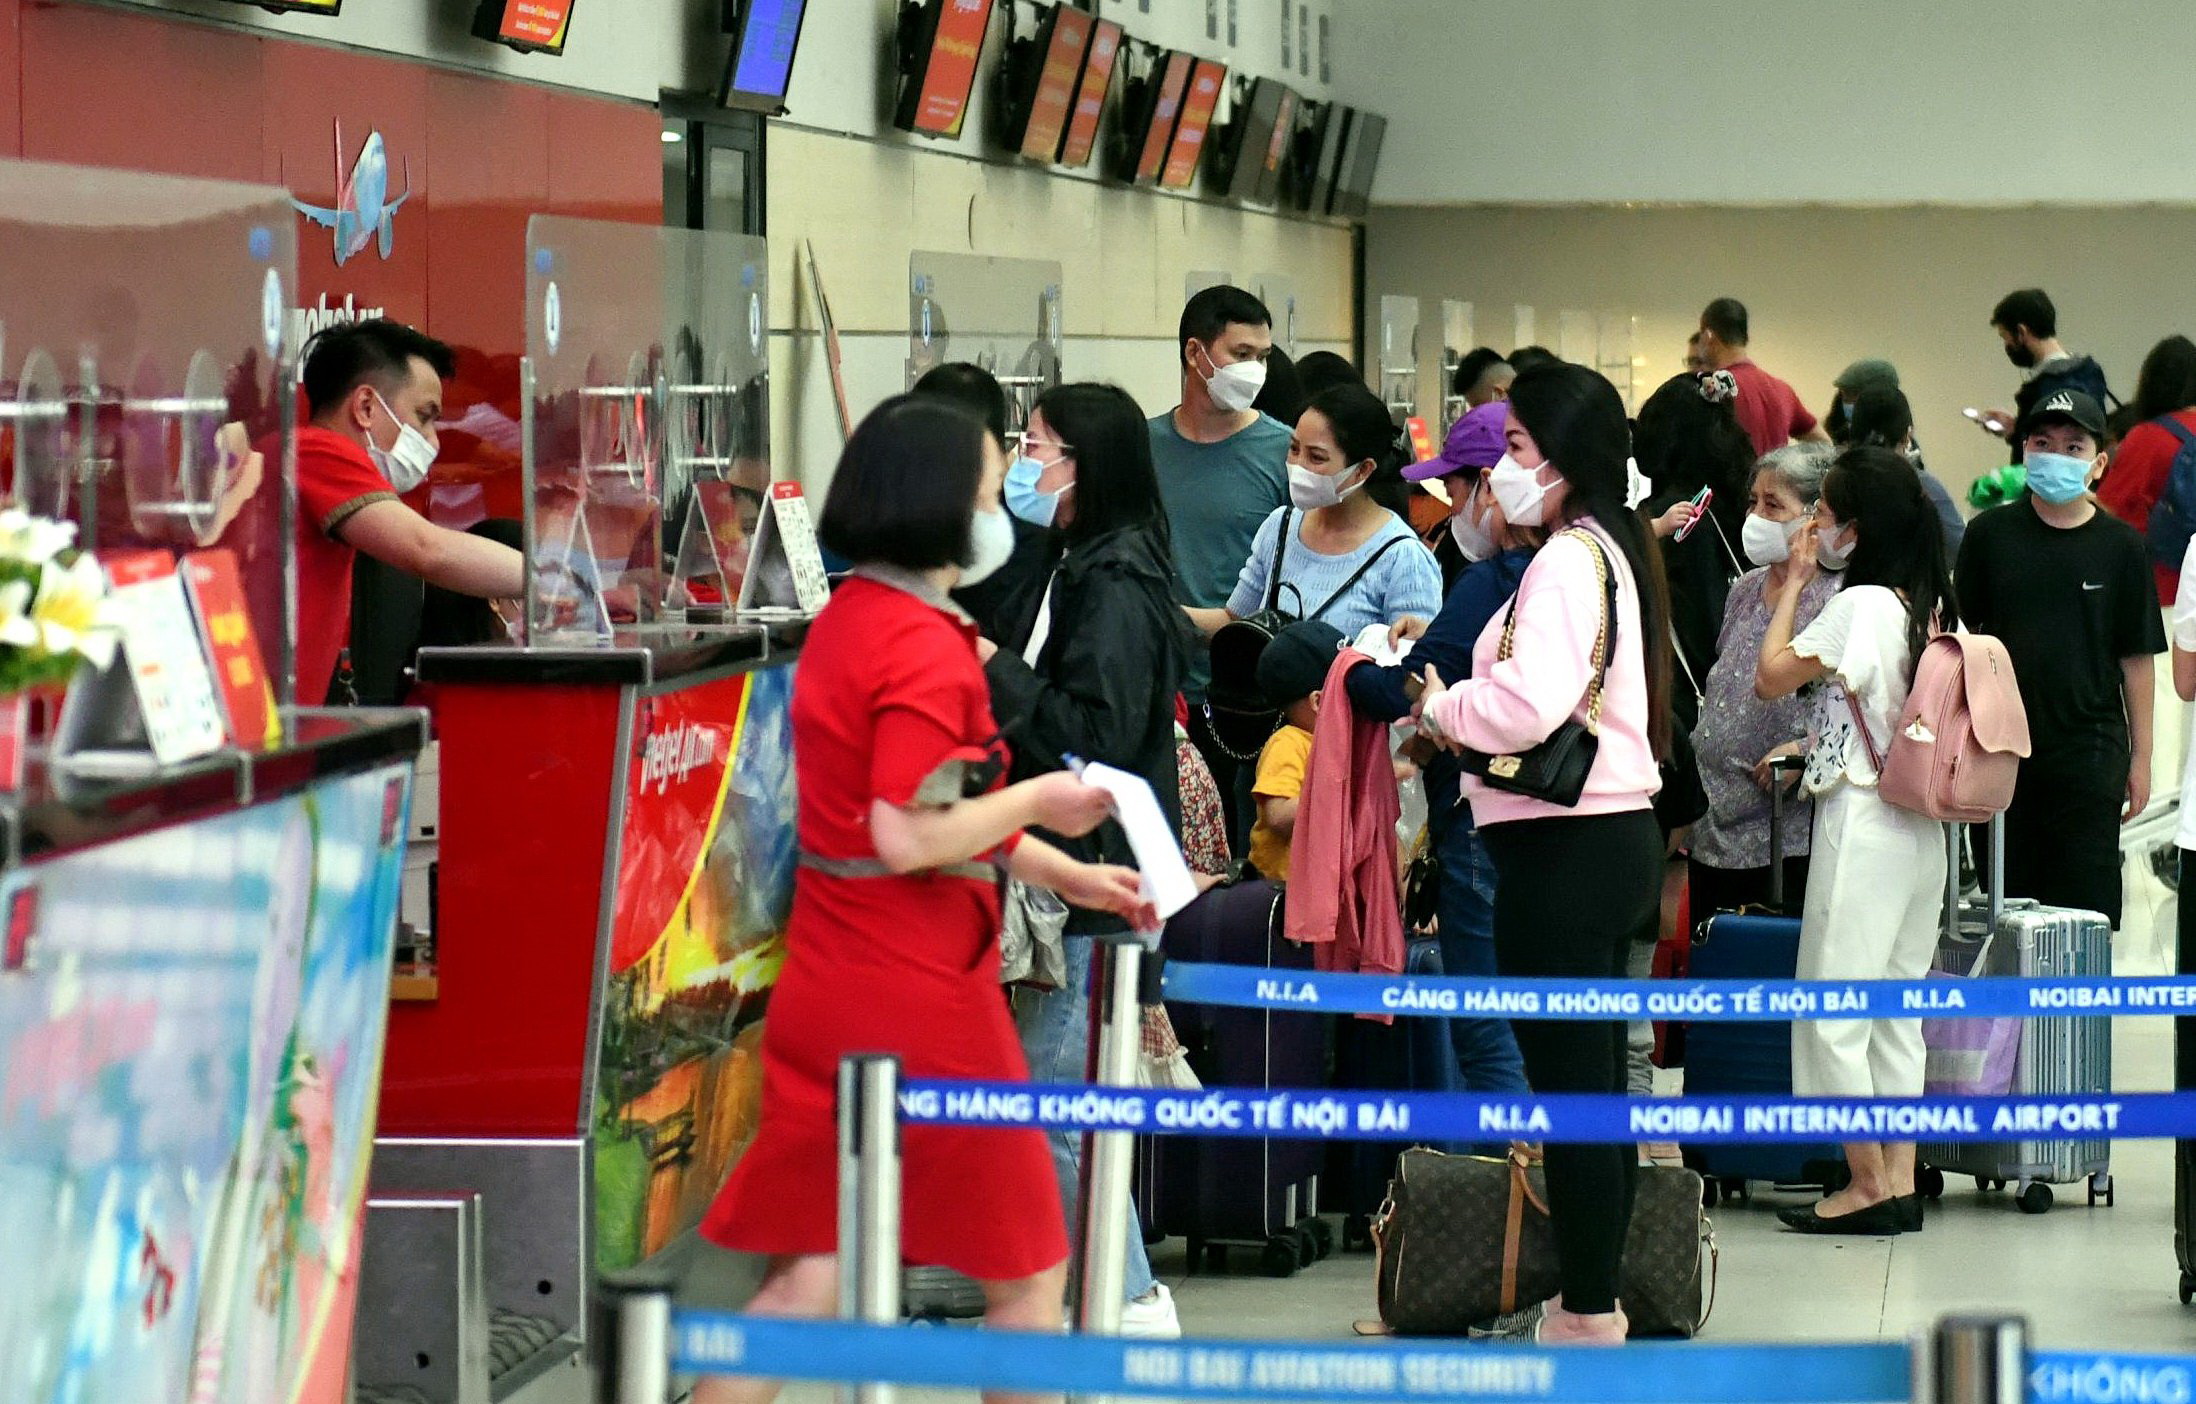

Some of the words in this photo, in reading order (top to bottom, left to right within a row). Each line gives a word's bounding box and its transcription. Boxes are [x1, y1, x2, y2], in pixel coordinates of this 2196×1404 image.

[1257, 980, 1317, 1003] N.I.A
[1382, 981, 1457, 1010] CẢNG
[1464, 986, 1539, 1012] HÀNG
[1547, 989, 1640, 1013] KHÔNG
[1647, 985, 1723, 1013] QUỐC
[1730, 985, 1763, 1012] TẾ
[1770, 988, 1816, 1017] NỘI
[1823, 986, 1868, 1011] BÀI
[1903, 988, 1965, 1009] N.I.A
[2028, 987, 2120, 1009] NOIBAI
[946, 1087, 1033, 1122] HÀNG
[1039, 1090, 1145, 1126] KHÔNG
[1155, 1090, 1243, 1129] QUỐC
[1249, 1091, 1291, 1129] TẾ
[1292, 1099, 1348, 1135] NỘI
[1356, 1101, 1409, 1132] BÀI
[1479, 1103, 1552, 1133] N.I.A
[1630, 1104, 1733, 1134] NOIBAI
[1744, 1104, 1978, 1134] INTERNATIONAL
[1991, 1102, 2122, 1133] AIRPORT
[1250, 1349, 1395, 1392] AVIATION
[1402, 1354, 1555, 1394] SECURITY
